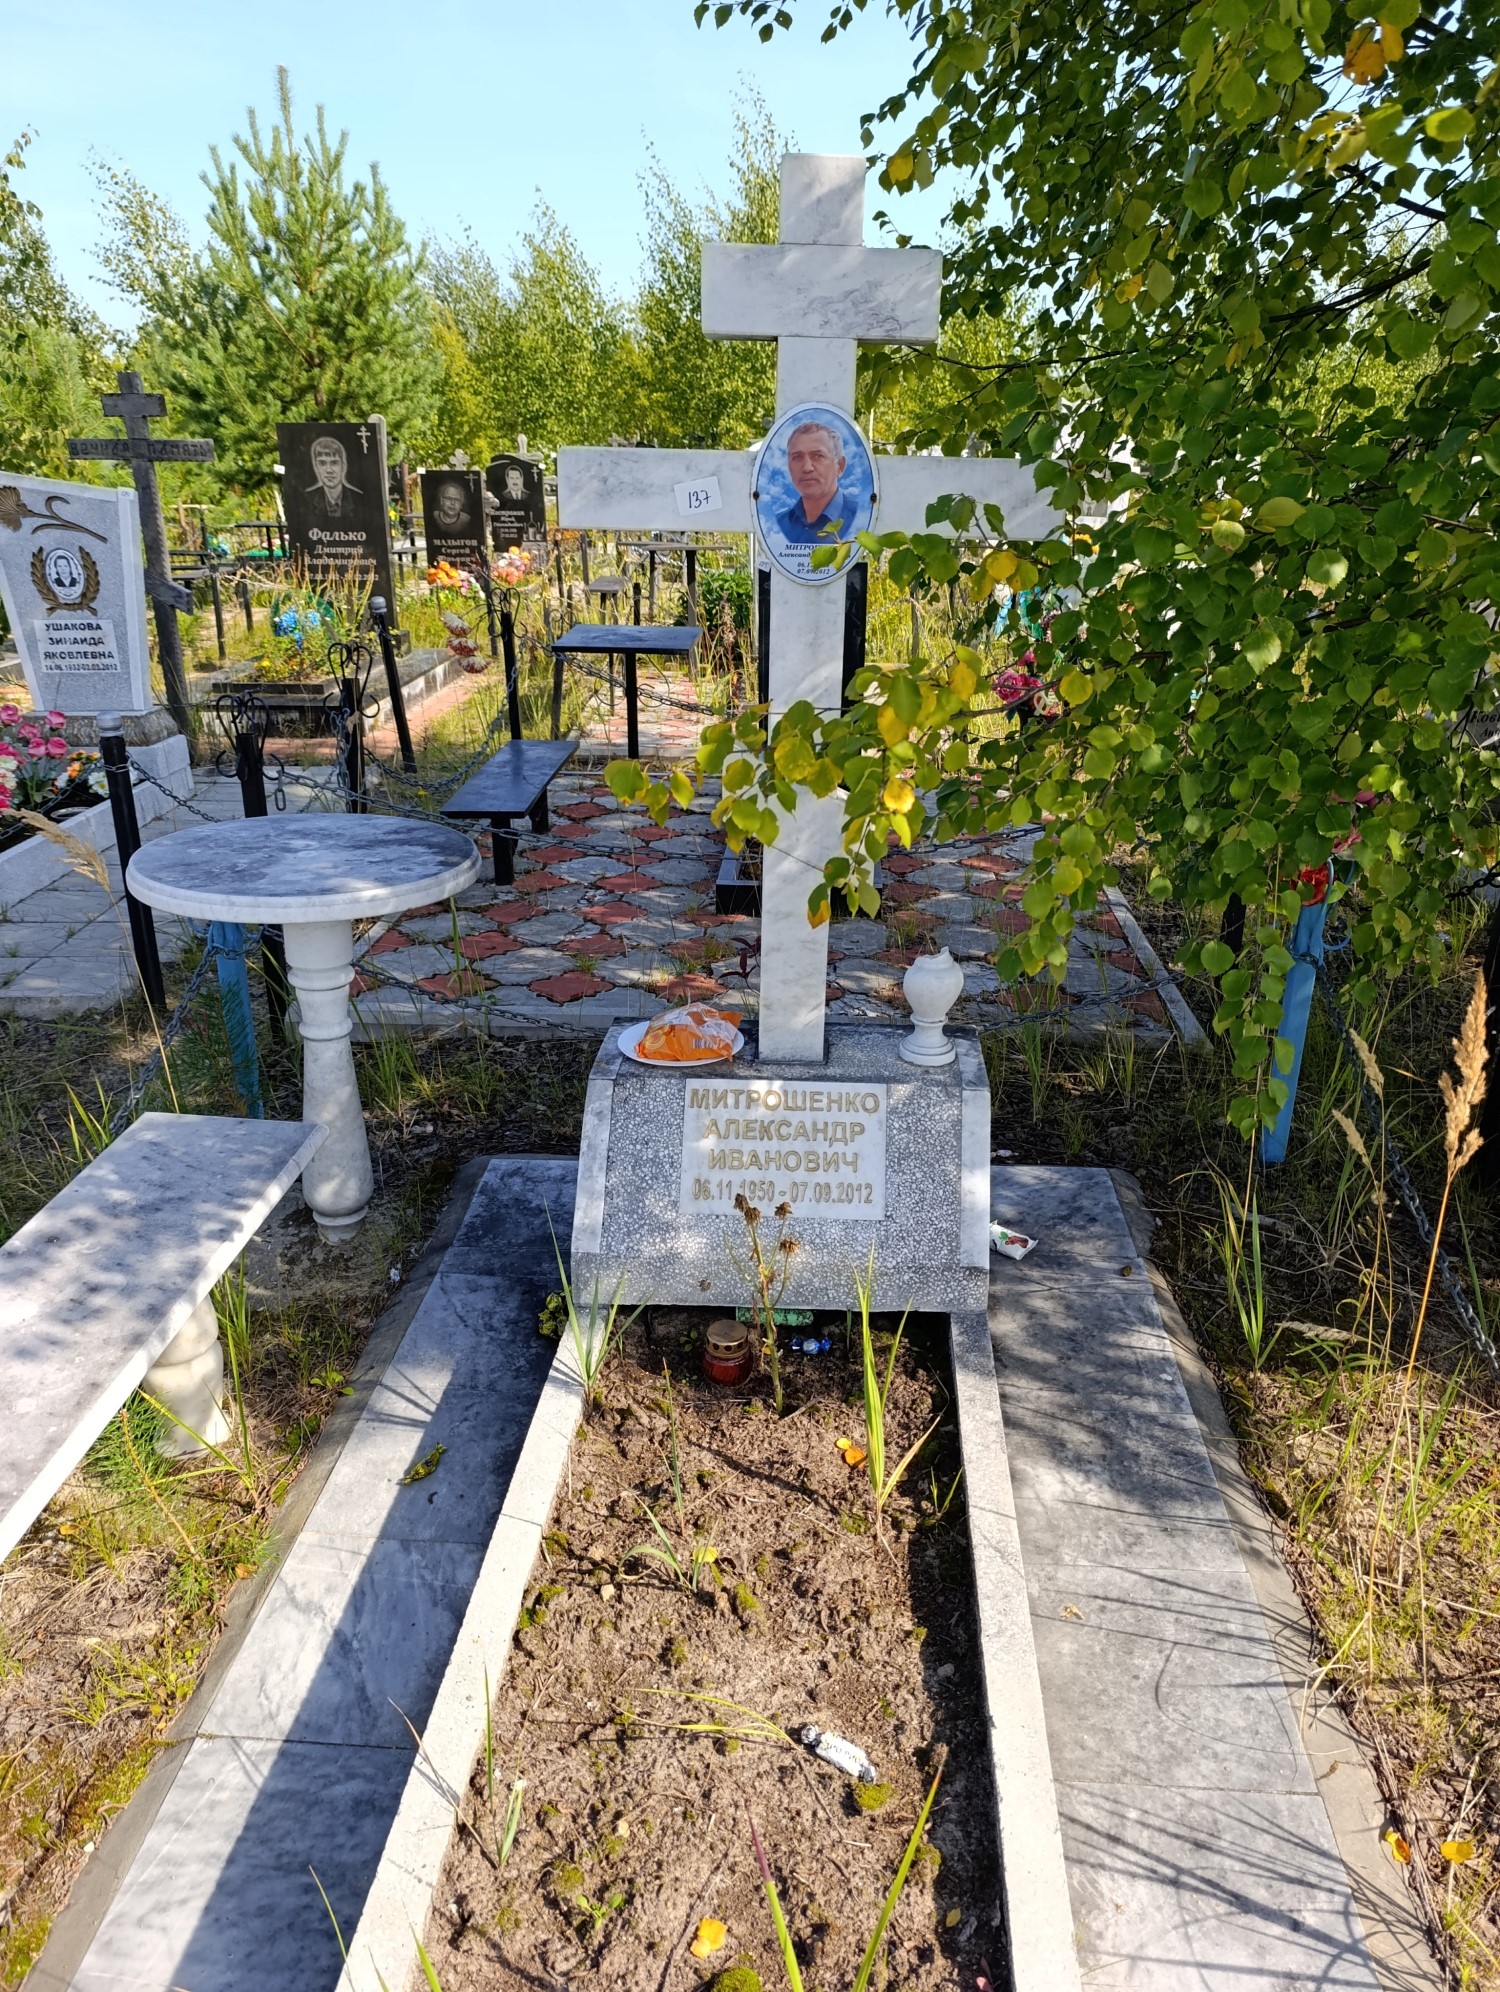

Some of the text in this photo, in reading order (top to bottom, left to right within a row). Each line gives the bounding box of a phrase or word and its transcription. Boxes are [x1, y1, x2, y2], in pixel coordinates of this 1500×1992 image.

[689, 490, 711, 508] 137
[308, 528, 367, 542] Фалько
[314, 545, 364, 556] Дмитрий
[441, 547, 470, 555] Сергей
[44, 622, 103, 631] УШАКОВА
[48, 637, 105, 646] ЗИНАИДА
[43, 651, 115, 660] ЯКОВЛЕВНА
[689, 1088, 880, 1113] МИТРОШЕНКО
[703, 1119, 865, 1147] АЛЕКСАНДР
[708, 1149, 858, 1173] ИВАНОВИЧ
[692, 1178, 775, 1201] 06.111950
[789, 1181, 873, 1204] 07.09.2012
